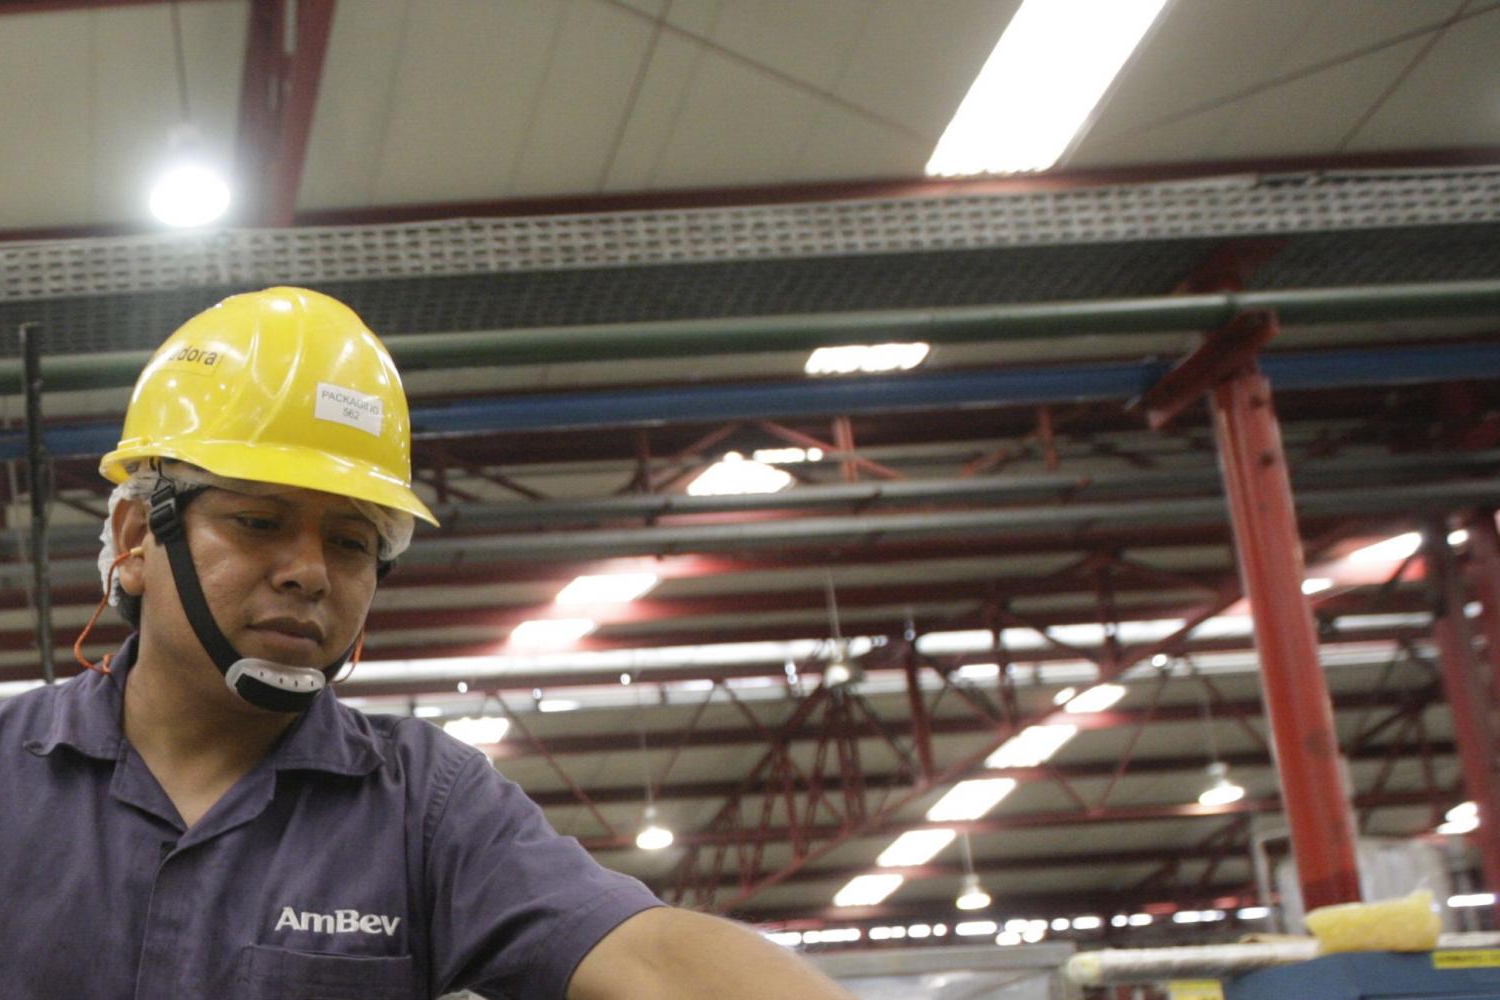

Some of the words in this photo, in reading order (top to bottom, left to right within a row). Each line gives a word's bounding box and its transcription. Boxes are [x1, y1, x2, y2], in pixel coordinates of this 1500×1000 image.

[168, 345, 218, 366] dora
[321, 390, 379, 416] PACKAGING
[274, 906, 401, 936] AmBev
